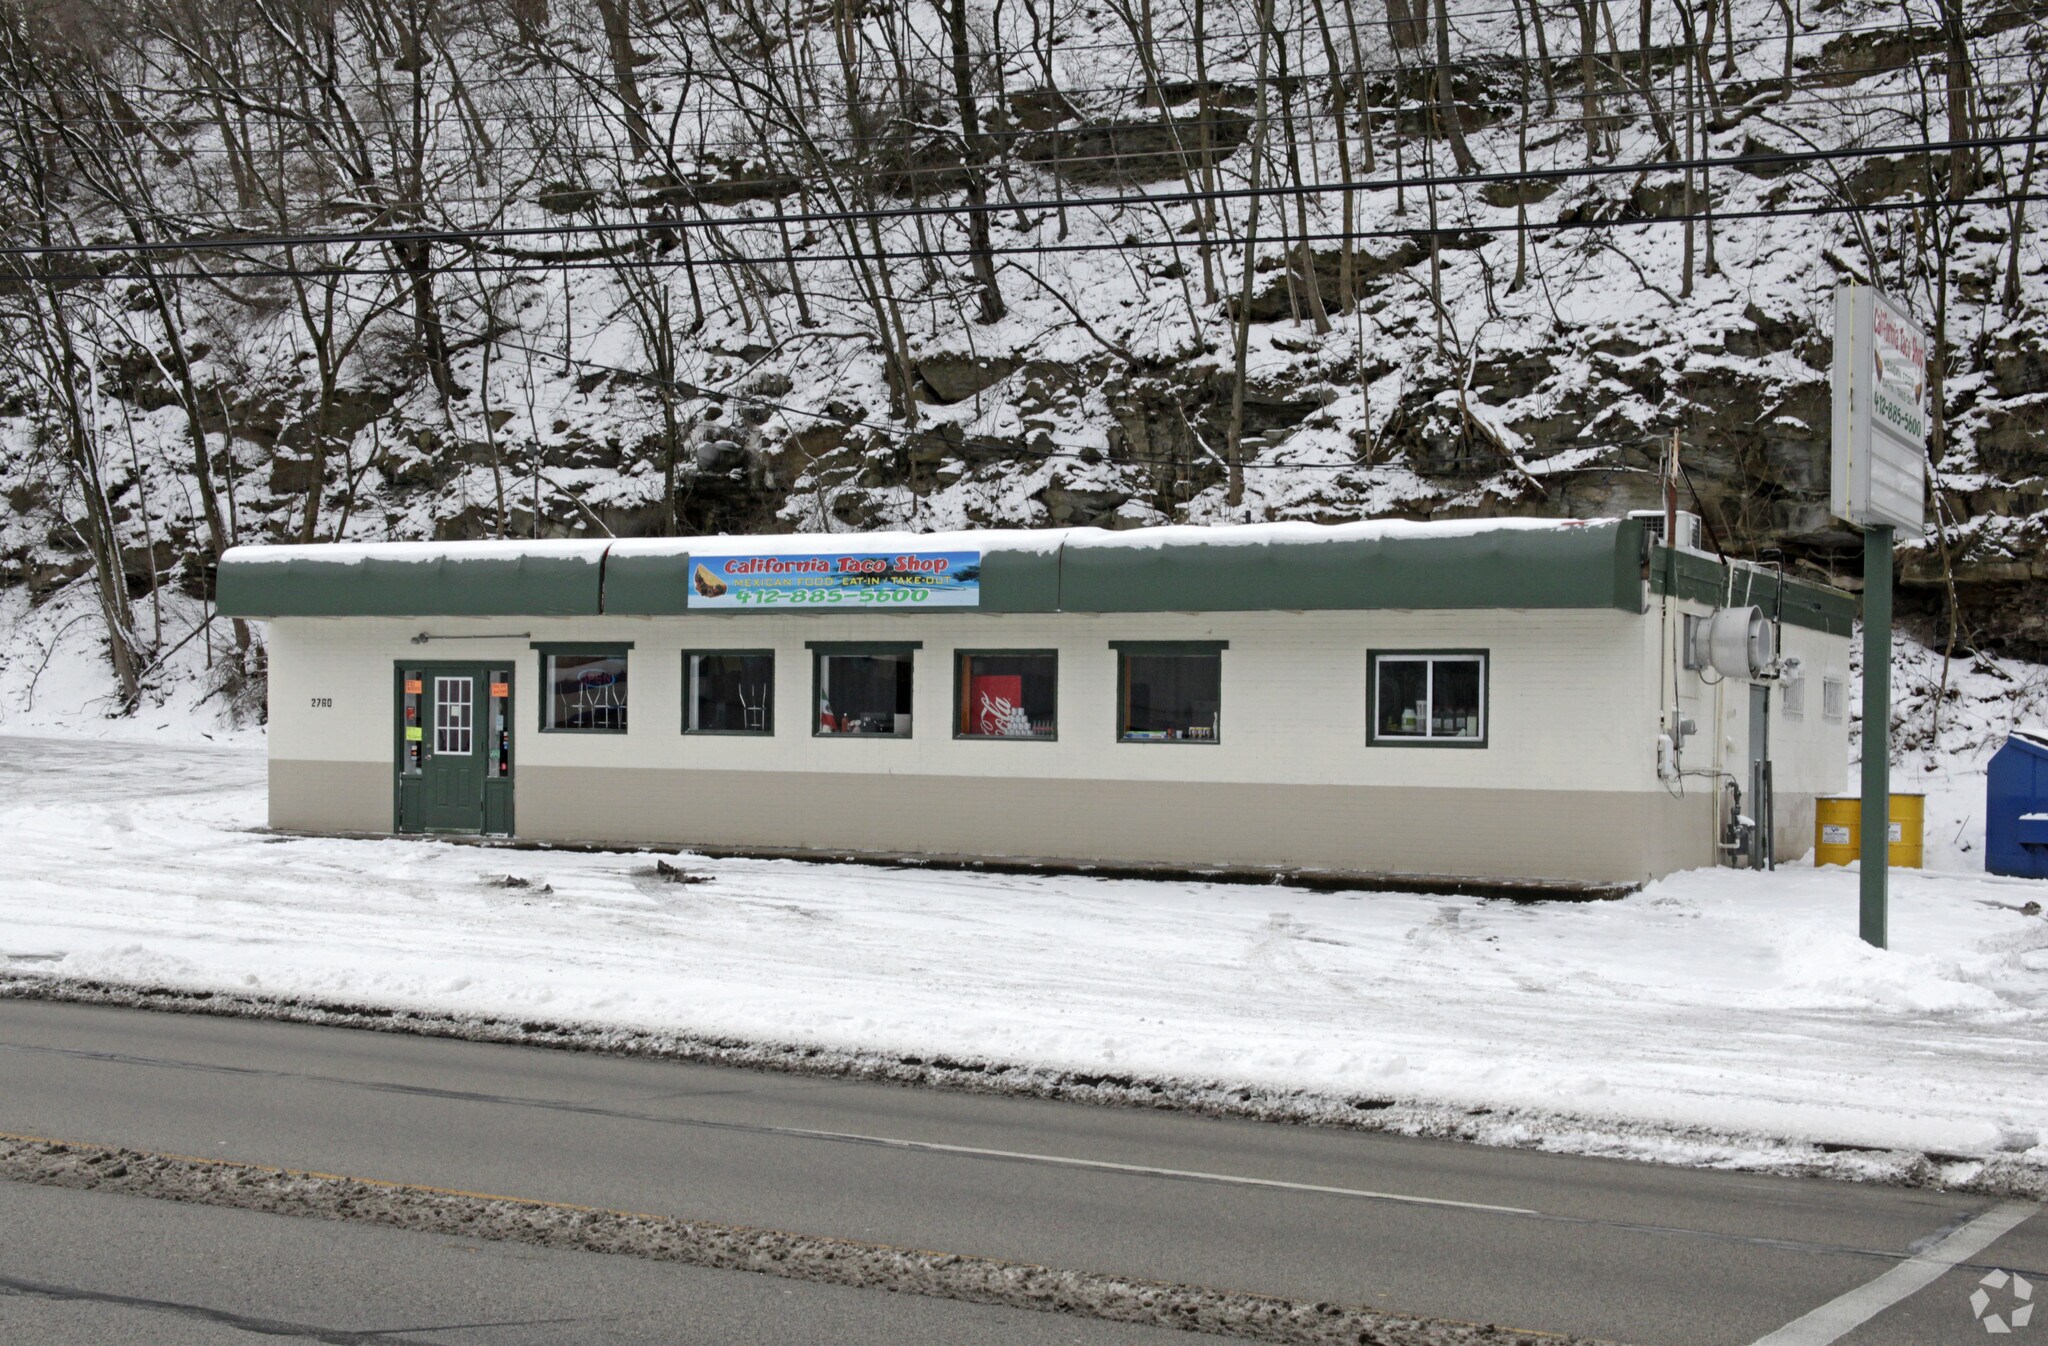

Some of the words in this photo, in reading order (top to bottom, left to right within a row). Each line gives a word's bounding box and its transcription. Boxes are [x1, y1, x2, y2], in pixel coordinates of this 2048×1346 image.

[1874, 391, 1922, 437] 412-885-5600
[724, 557, 829, 574] California
[837, 556, 886, 573] Taco
[894, 554, 948, 574] Shop
[735, 578, 792, 587] MEXICAN
[797, 577, 834, 587] FOOD
[842, 576, 880, 586] EAT-IN
[891, 575, 951, 585] TAKE-OUT
[736, 588, 930, 604] 412-885-5600
[311, 698, 332, 708] 2760
